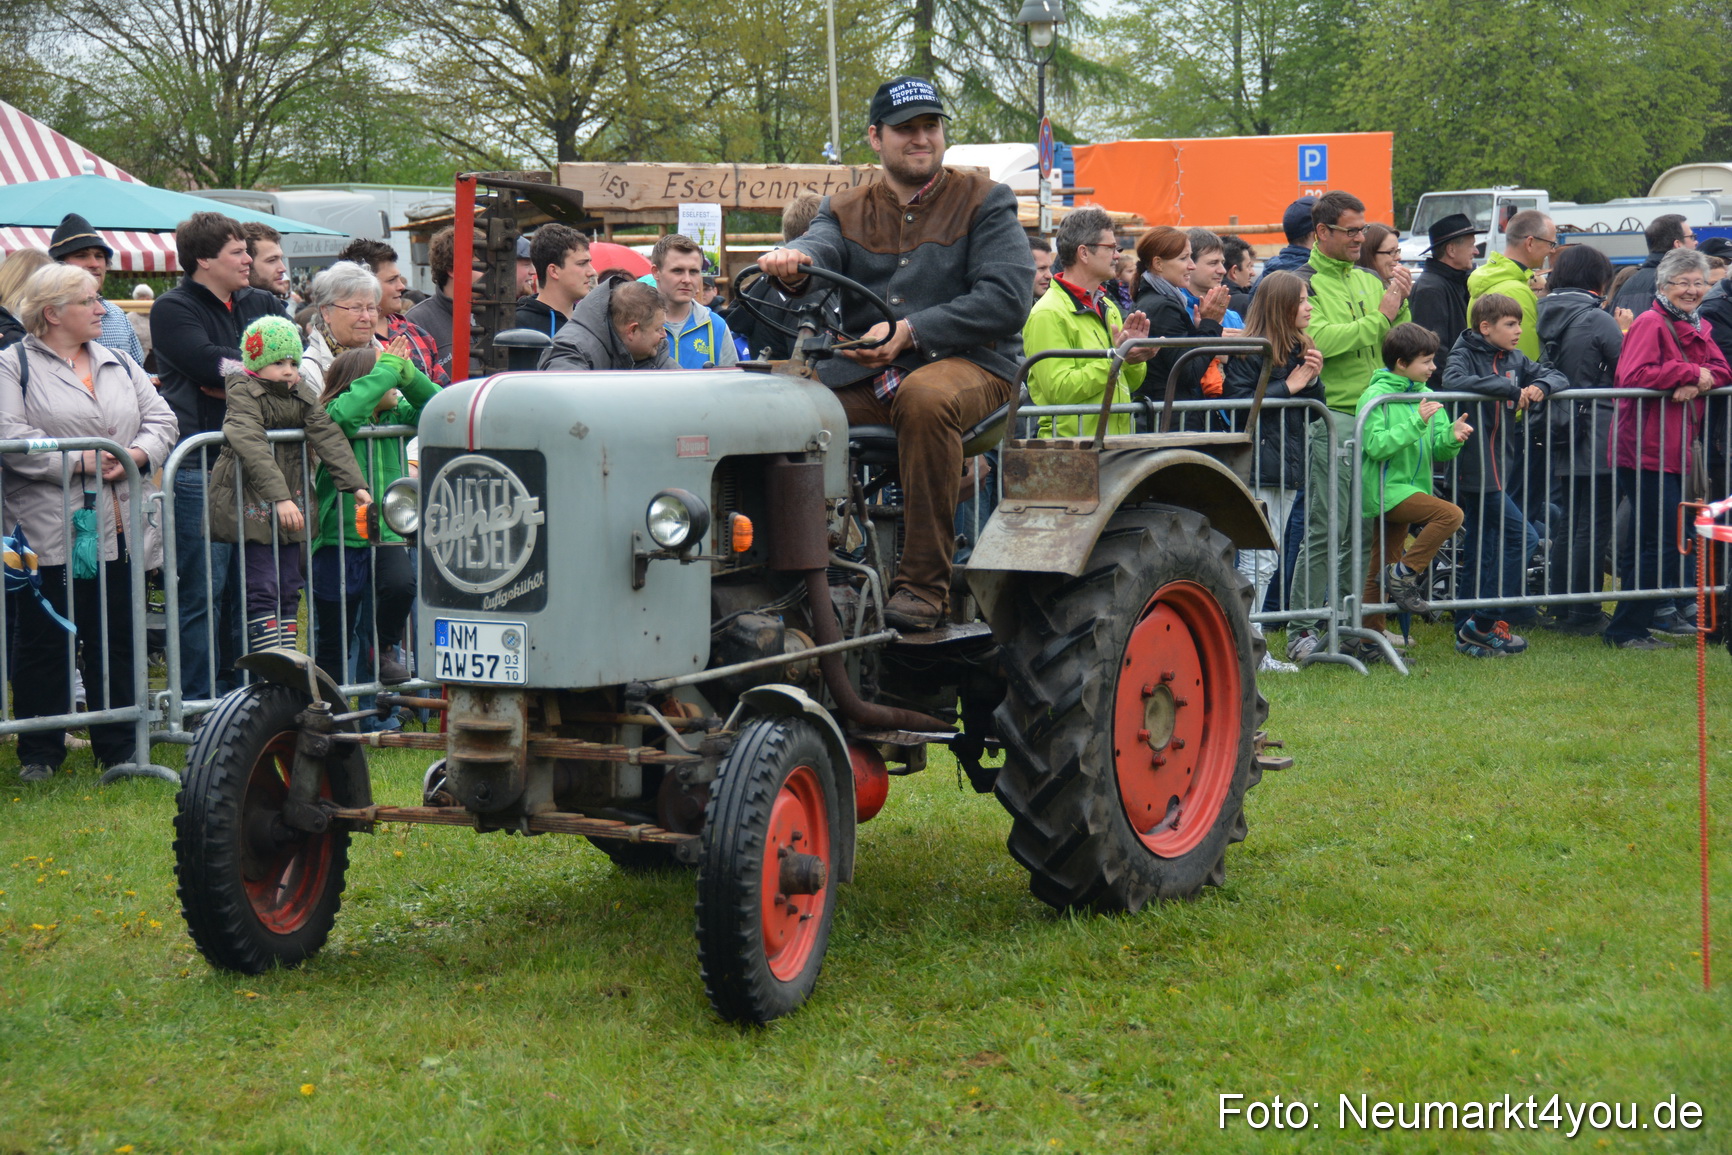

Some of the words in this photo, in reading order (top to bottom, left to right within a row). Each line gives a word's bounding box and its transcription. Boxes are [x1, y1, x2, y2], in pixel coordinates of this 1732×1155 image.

[891, 88, 918, 99] TROPFT
[1305, 149, 1321, 178] P
[424, 496, 545, 550] Eicher
[439, 477, 515, 570] DIESEL
[482, 570, 545, 611] luftgekühlt
[440, 636, 446, 645] D
[451, 624, 477, 650] NM
[442, 651, 467, 677] AW
[472, 653, 500, 679] 57
[504, 655, 519, 665] 03
[505, 670, 519, 681] 10
